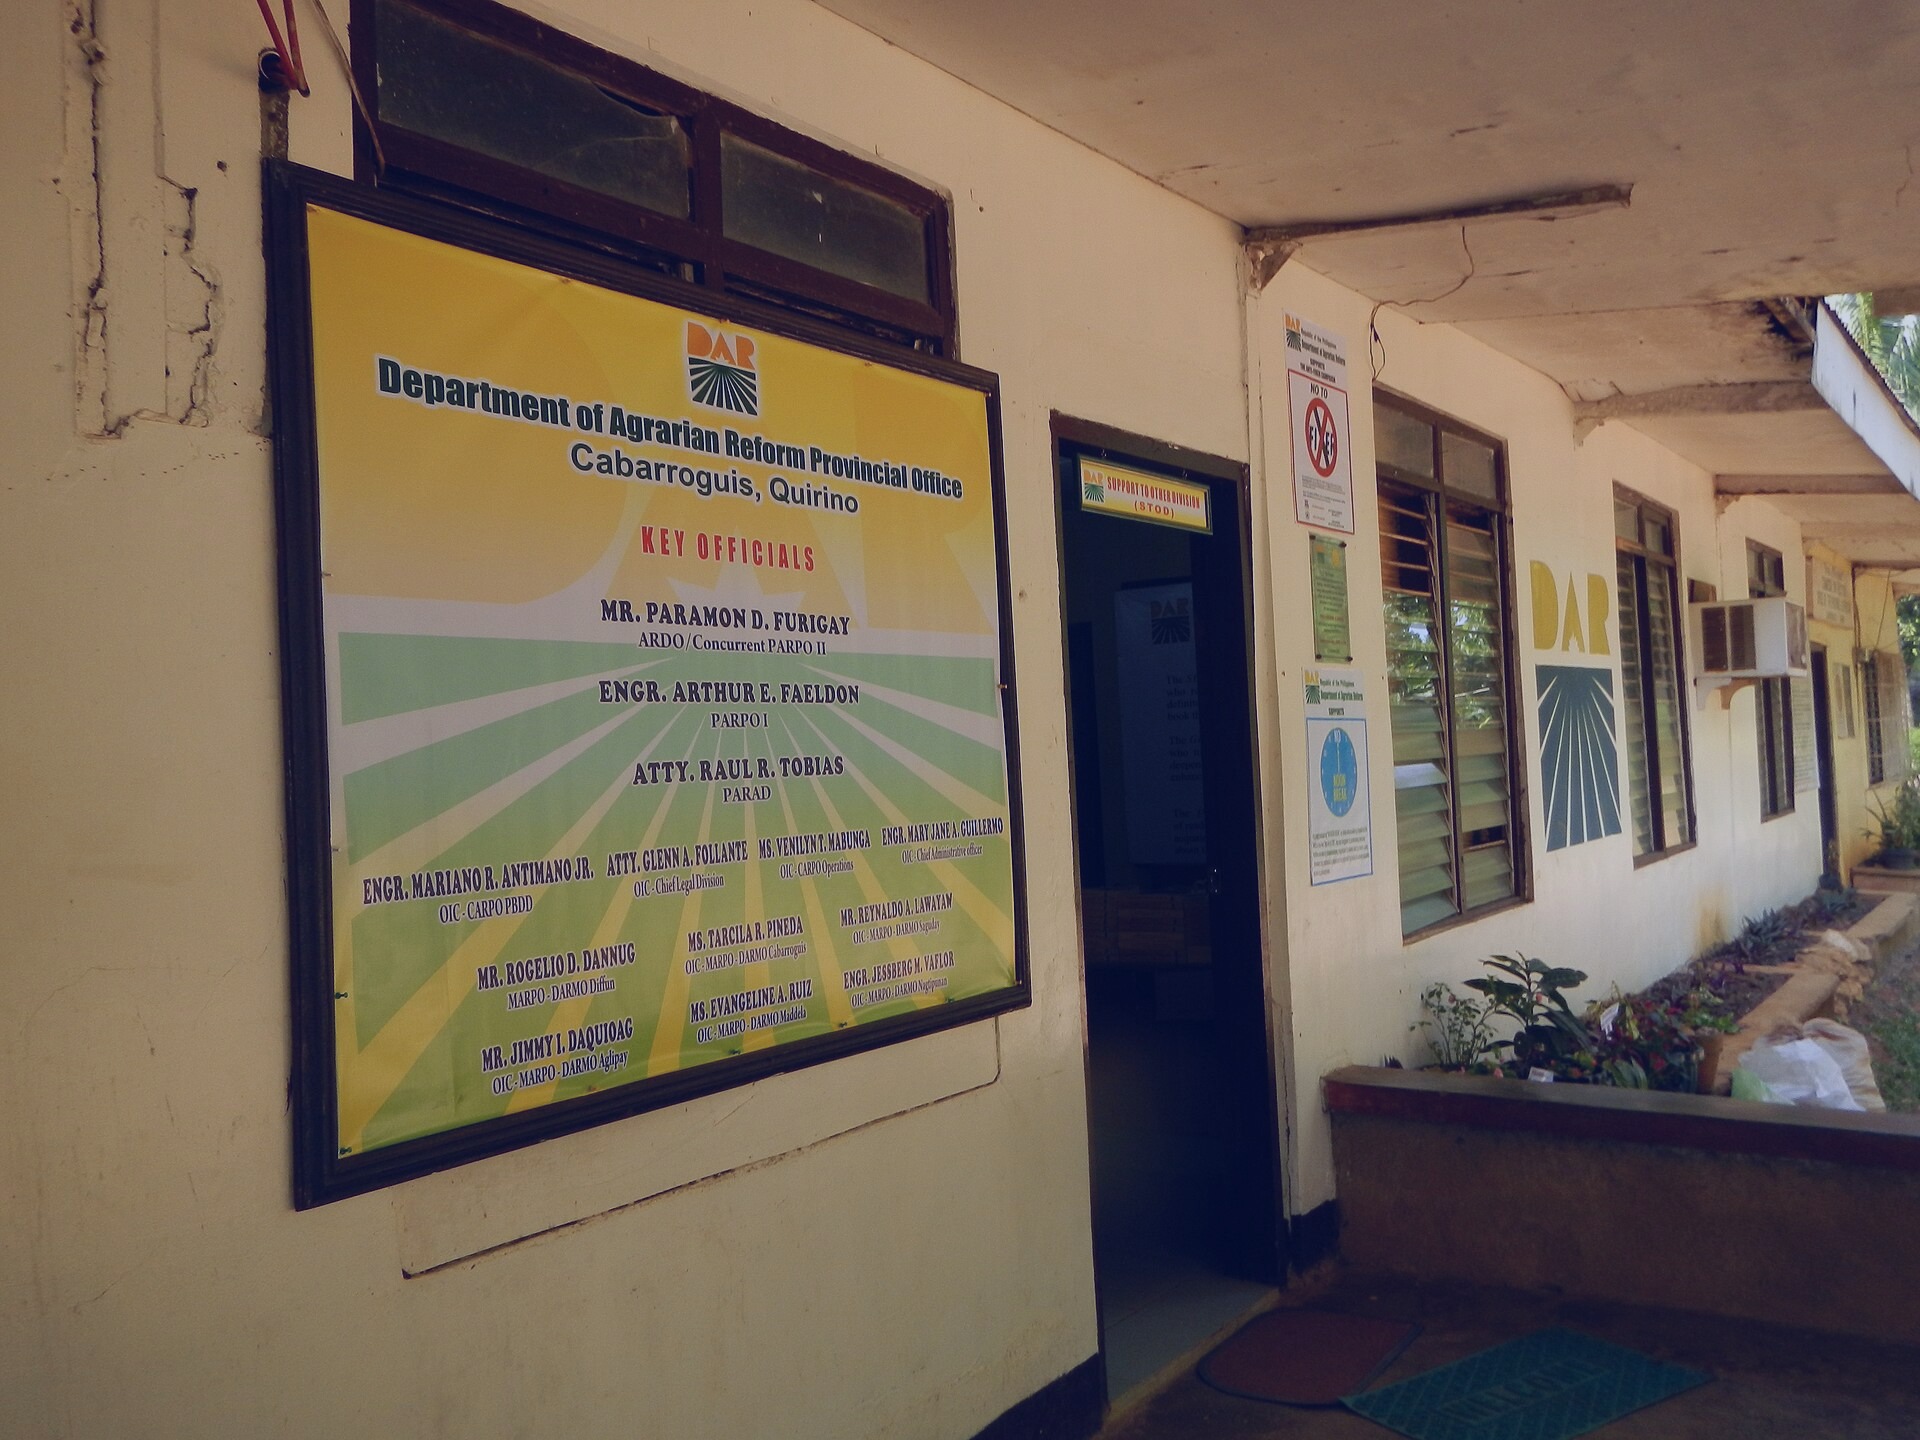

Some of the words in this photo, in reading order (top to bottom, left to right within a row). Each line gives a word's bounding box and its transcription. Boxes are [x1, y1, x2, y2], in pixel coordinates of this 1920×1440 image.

[686, 321, 755, 369] DAR
[1310, 382, 1319, 395] NO
[1321, 387, 1328, 398] TO
[378, 357, 570, 428] Department
[576, 403, 604, 433] of
[609, 406, 720, 455] Agrarian
[725, 429, 805, 471] Reform
[810, 447, 908, 490] Provincial
[911, 467, 963, 499] Office
[570, 442, 762, 503] Cabarroguis,
[769, 477, 859, 514] Quirino
[1083, 469, 1103, 485] DAR
[1107, 476, 1139, 496] SUPPORT
[1140, 484, 1149, 498] TO
[1150, 487, 1171, 503] OTHER
[1172, 490, 1200, 509] DIVISION
[1134, 500, 1175, 519] (STOD)
[641, 526, 685, 557] KEY
[697, 532, 815, 572] OFFICIALS
[600, 599, 641, 623] MR.
[646, 602, 746, 629] PARAMON
[751, 609, 769, 630] D.
[773, 611, 850, 635] FURIGAY
[1529, 559, 1610, 656] DAR
[638, 631, 766, 654] ARDO/Concurrent
[768, 639, 813, 656] PARPO
[816, 642, 827, 655] II
[599, 680, 667, 703] ENGR.
[672, 681, 756, 703] ARTHUR
[760, 683, 776, 703] E.
[780, 683, 859, 704] FAELDON
[711, 712, 760, 728] PARPO
[763, 713, 769, 728] I
[633, 760, 695, 785] ATTY.
[700, 759, 754, 781] RAUL
[757, 758, 775, 779] R.
[780, 756, 844, 778] TOBIAS
[723, 785, 772, 803] PARAD
[758, 838, 775, 859] MS.
[776, 834, 816, 857] VENILYN
[818, 834, 827, 852] T.
[828, 830, 871, 852] MABUNGA
[882, 827, 906, 846] ENGR.
[907, 824, 929, 842] MARY
[931, 822, 950, 840] JANE
[952, 821, 960, 838] A.
[961, 817, 1004, 836] GUILLERMO
[607, 852, 640, 876] ATTY.
[642, 847, 680, 872] GLENN
[683, 846, 693, 867] A.
[695, 840, 748, 866] FOLLANTE
[780, 863, 793, 879] OIC
[798, 860, 821, 877] CARPO
[822, 858, 854, 877] Operations
[363, 876, 409, 905] ENGR.
[411, 866, 482, 899] MARIANO
[485, 866, 498, 891] R.
[502, 858, 572, 889] ANTIMANO
[574, 857, 594, 881] JR.
[634, 881, 650, 898] OIC
[656, 874, 676, 894] Chief
[676, 873, 695, 896] Legal
[695, 873, 724, 892] Division
[440, 903, 460, 924] OIC
[468, 898, 503, 921] CARPO
[505, 895, 533, 915] PBDD
[840, 908, 857, 927] MR.
[858, 900, 903, 924] REYNALDO
[905, 899, 914, 916] A.
[688, 931, 706, 952] MS.
[708, 923, 753, 949] TARCILA
[755, 922, 765, 941] R.
[767, 916, 803, 939] PINEDA
[853, 930, 866, 944] OIC
[870, 925, 892, 941] MARPO
[896, 921, 919, 937] DARMO
[477, 965, 503, 990] MR.
[506, 954, 565, 985] ROGELIO
[567, 952, 580, 974] D.
[582, 942, 636, 974] DANNUG
[685, 958, 701, 975] OIC
[705, 953, 734, 971] MARPO
[739, 947, 768, 965] DARMO
[844, 968, 870, 989] ENGR.
[872, 959, 913, 983] JESSBERG
[914, 957, 923, 975] M.
[508, 988, 545, 1010] MARPO
[551, 980, 588, 1002] DARMO
[589, 975, 615, 995] Diffun
[690, 1001, 708, 1023] MS.
[711, 986, 775, 1018] EVANGELINE
[777, 985, 787, 1004] A.
[789, 979, 813, 1001] RUIZ
[851, 991, 864, 1008] OIC
[868, 987, 891, 1004] MARPO
[895, 981, 917, 997] DARMO
[697, 1026, 713, 1043] OIC
[718, 1019, 746, 1038] MARPO
[750, 1012, 779, 1030] DARMO
[481, 1046, 507, 1073] MR.
[510, 1034, 554, 1065] JIMMY
[568, 1017, 633, 1054] DAQUIOAG
[493, 1074, 513, 1095] OIC
[519, 1065, 556, 1088] MARPO
[562, 1055, 597, 1078] DARMO
[599, 1049, 628, 1073] Aglipay
